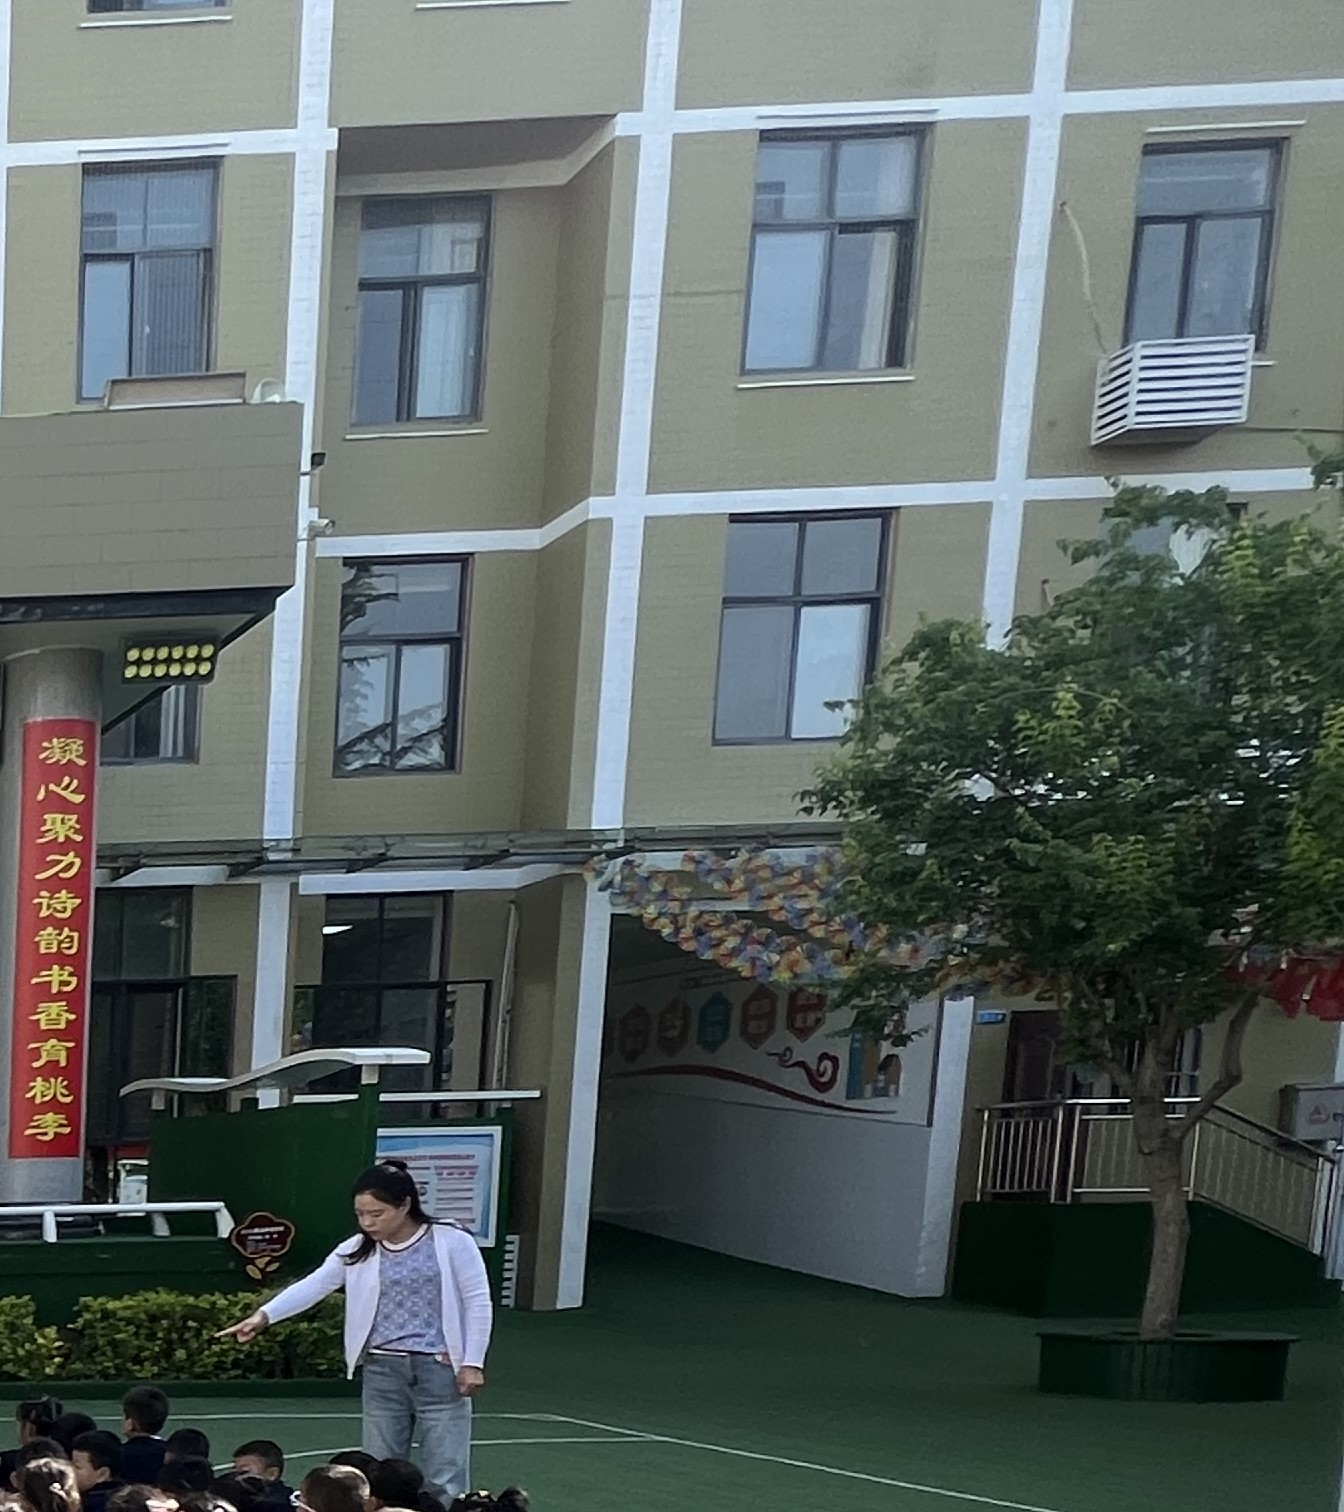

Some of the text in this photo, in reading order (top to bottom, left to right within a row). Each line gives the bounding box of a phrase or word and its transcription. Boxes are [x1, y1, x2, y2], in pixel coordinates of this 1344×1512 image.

[23, 736, 88, 1142] 凝心聚力诗韵书香育桃李
